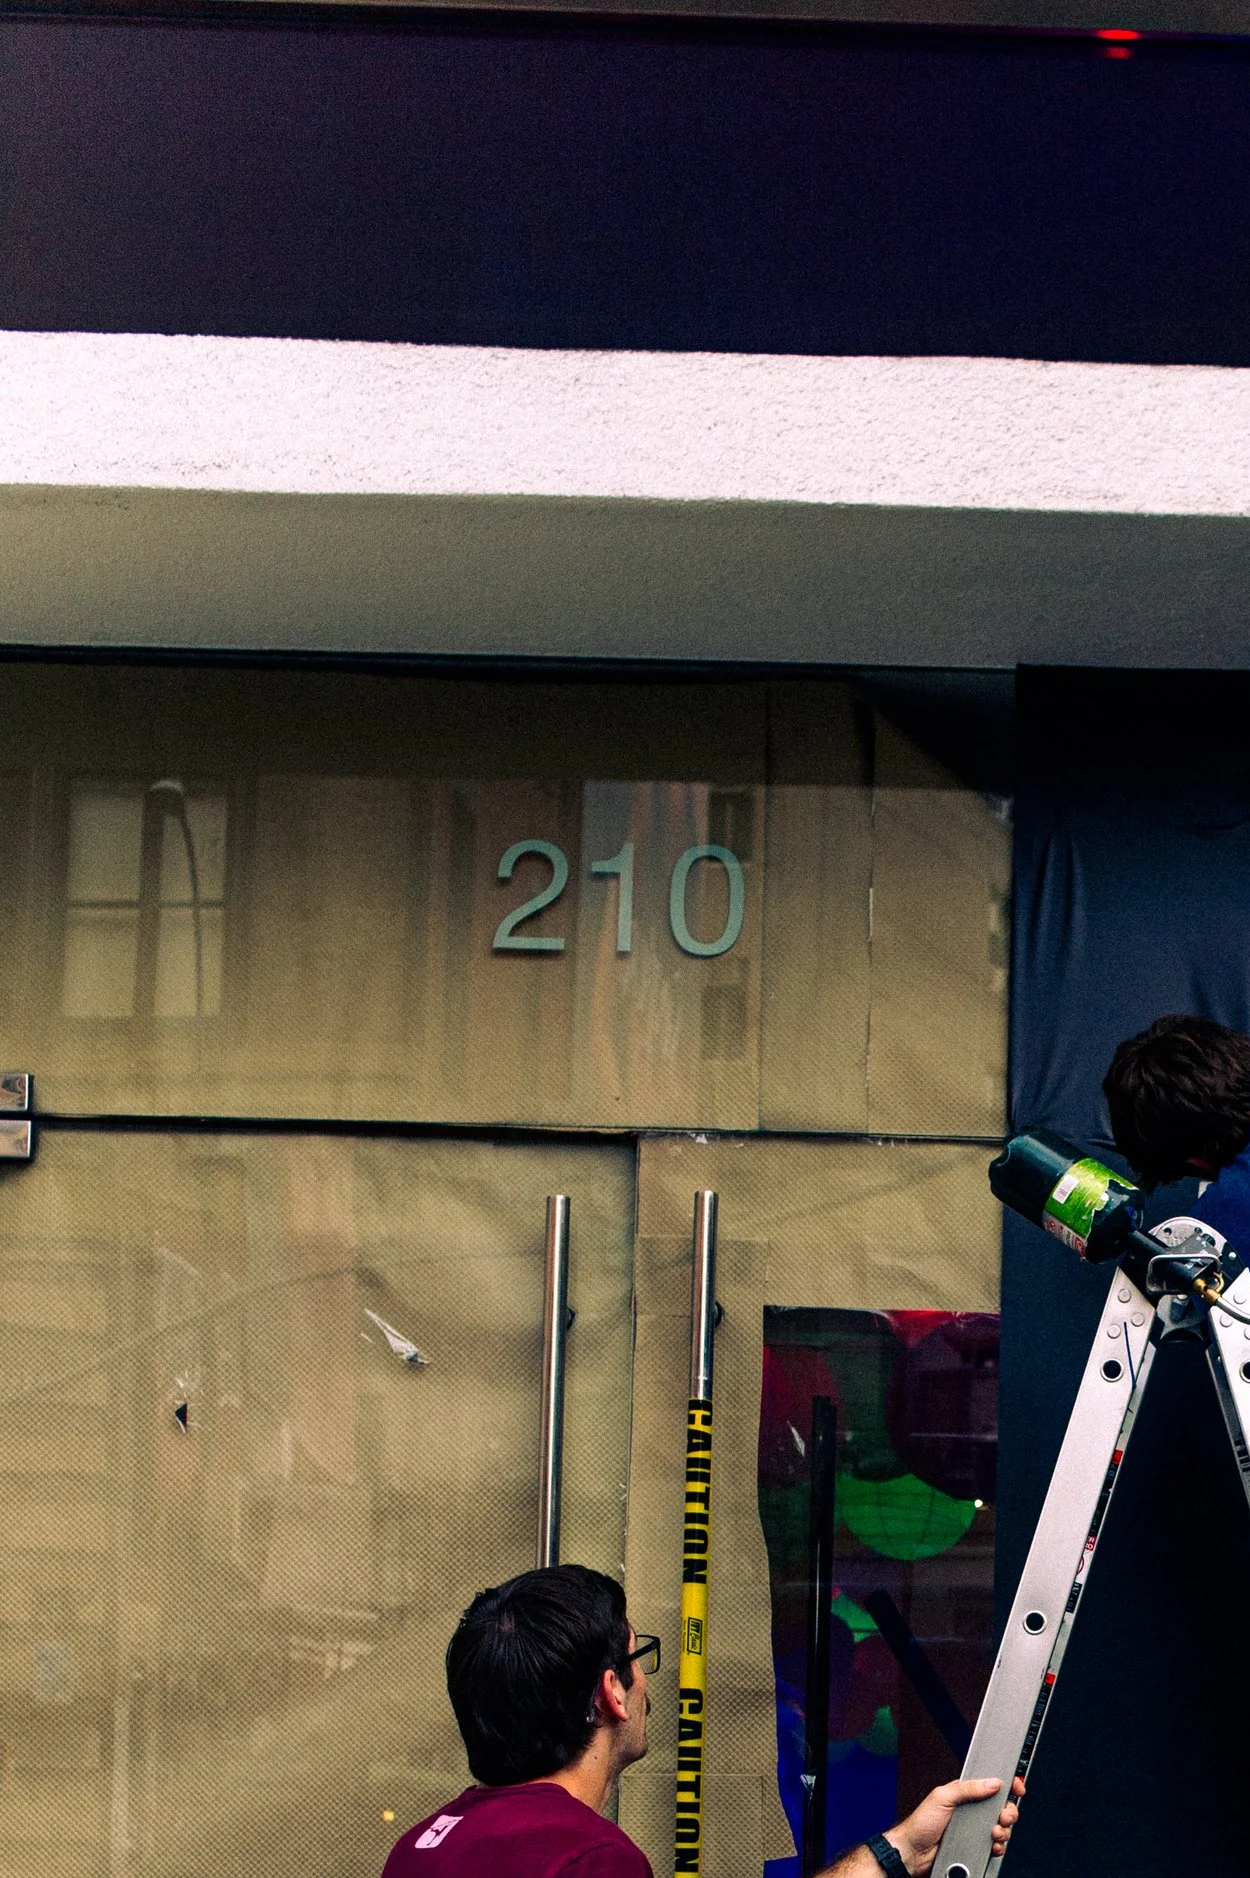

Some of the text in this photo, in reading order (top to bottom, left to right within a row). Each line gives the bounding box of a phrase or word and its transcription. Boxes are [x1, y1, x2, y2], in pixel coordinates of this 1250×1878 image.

[492, 838, 745, 957] 210
[682, 1399, 713, 1584] CAUTION
[674, 1687, 704, 1873] CAUTION
